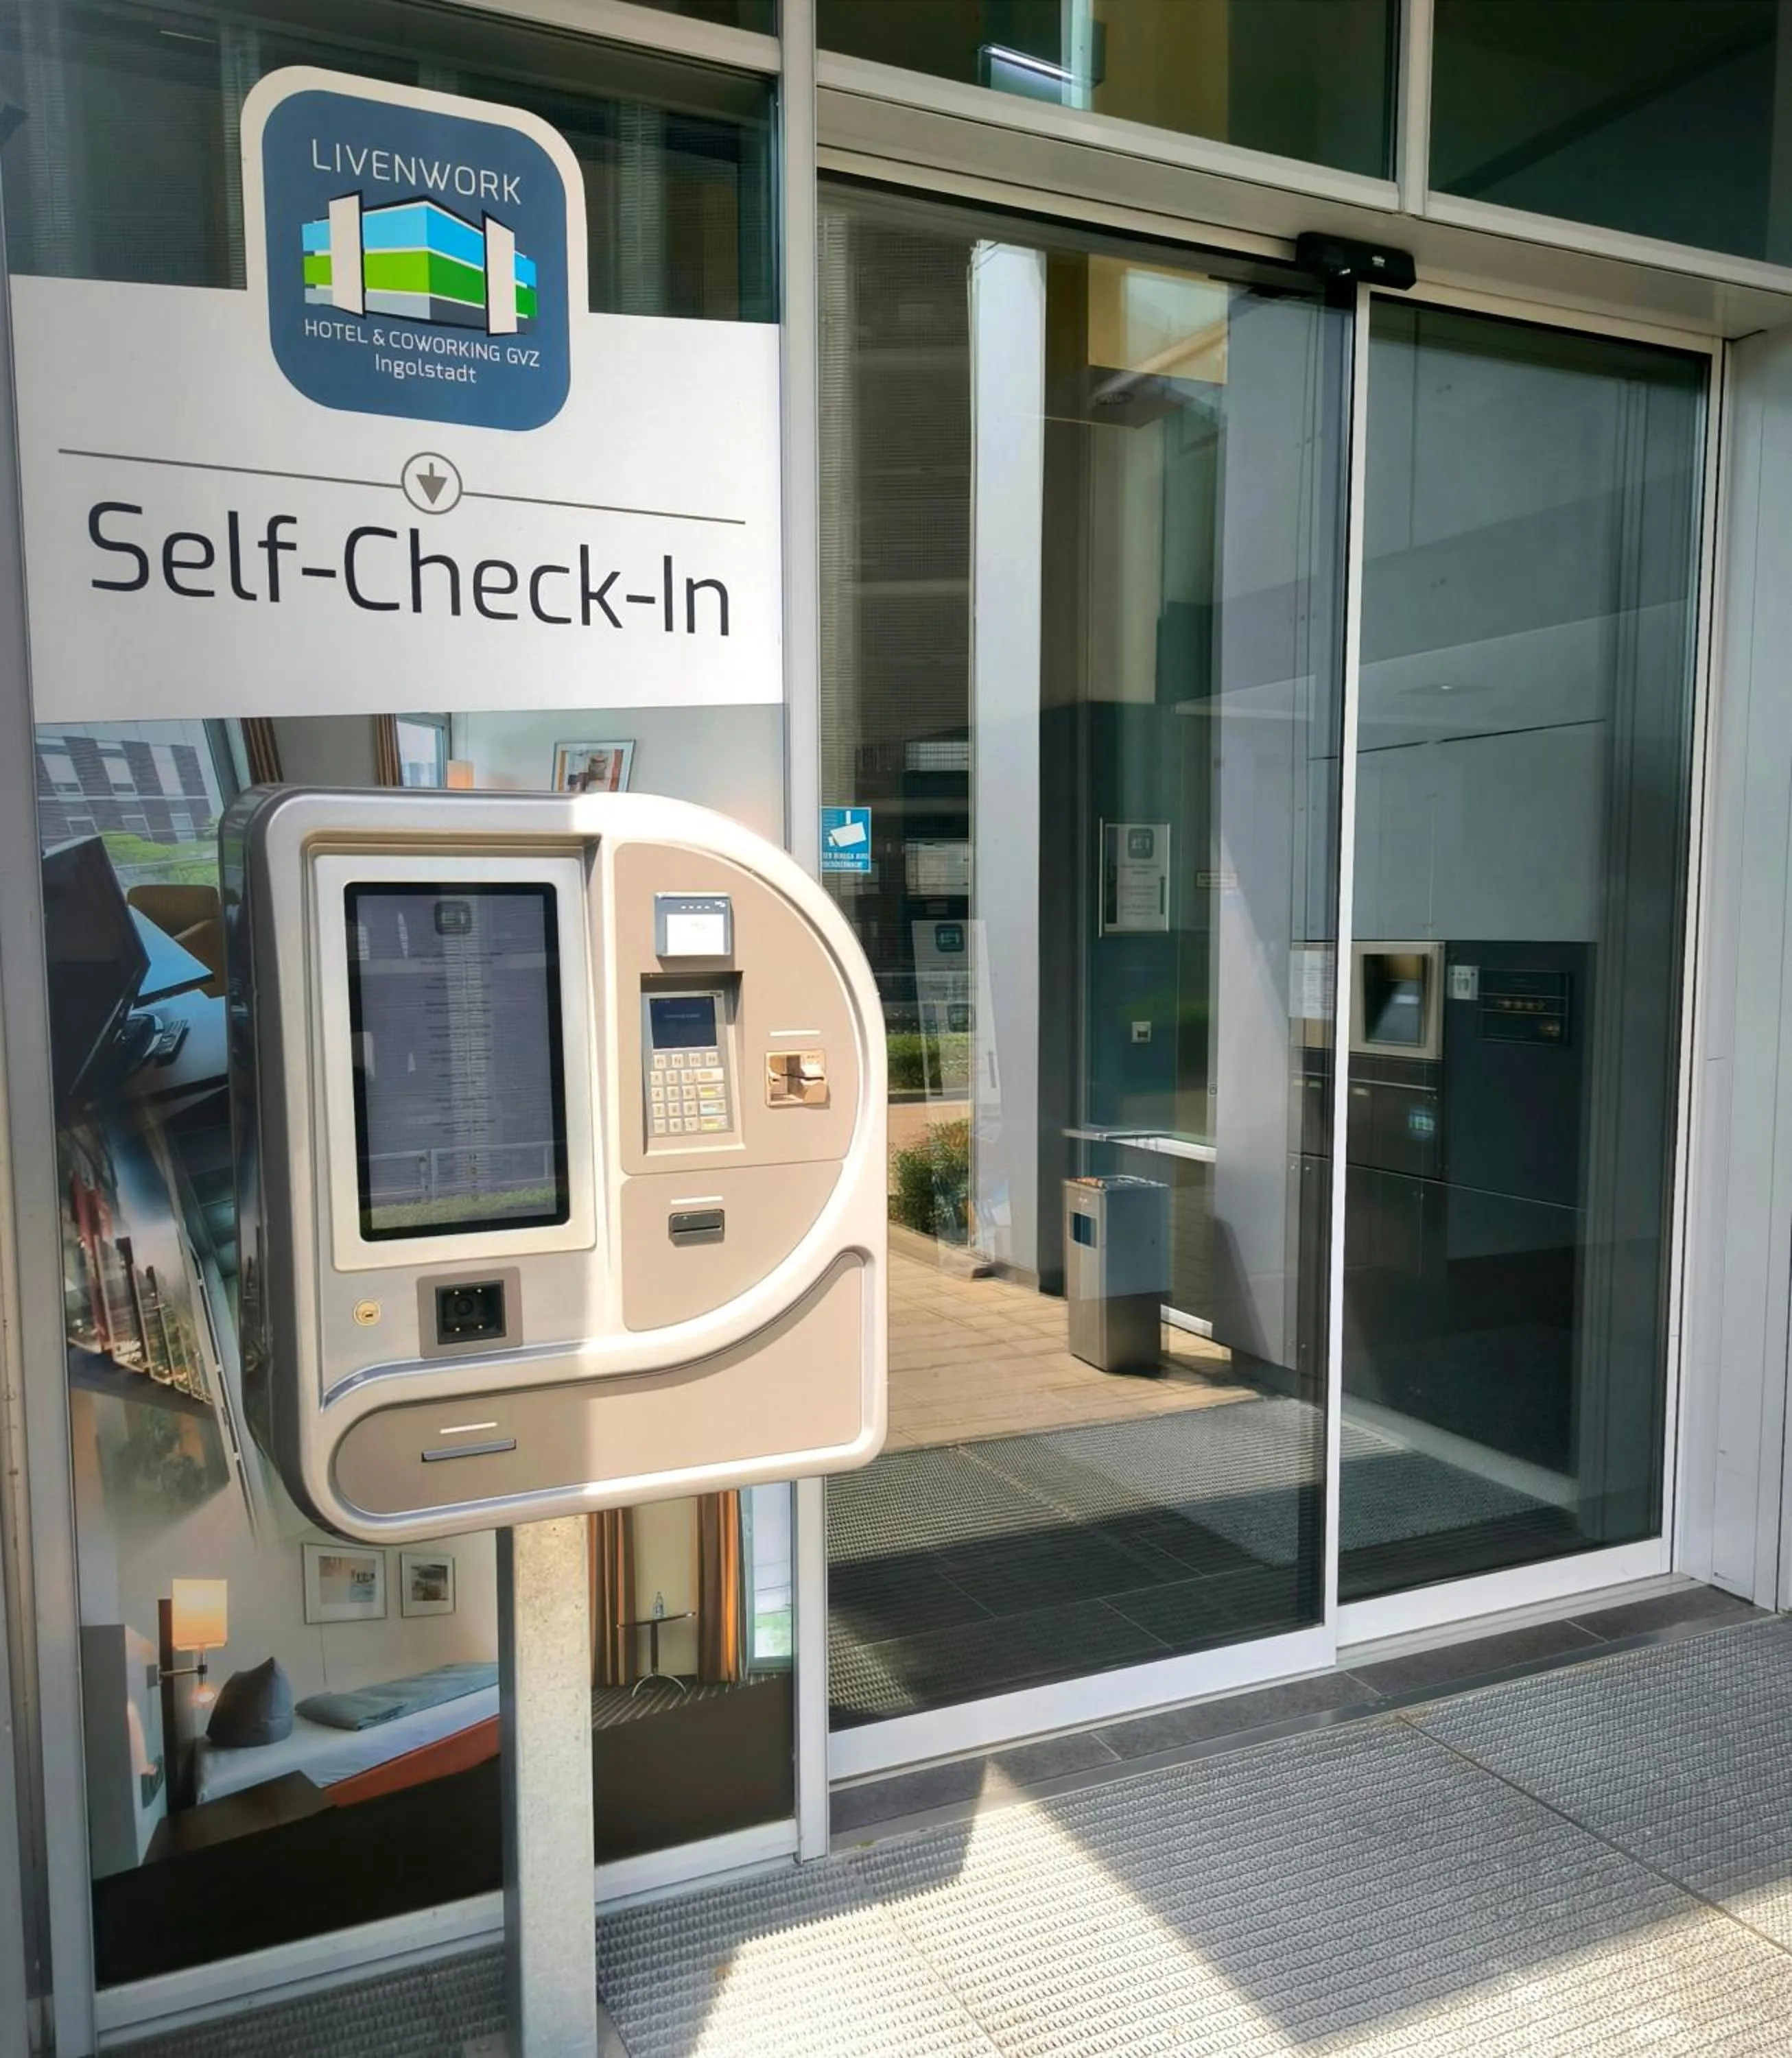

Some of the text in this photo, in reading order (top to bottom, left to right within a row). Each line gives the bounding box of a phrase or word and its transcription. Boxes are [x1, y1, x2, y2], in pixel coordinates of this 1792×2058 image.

[311, 139, 521, 205] LIVENWORK
[304, 318, 541, 368] HOTEL & COWORKING GVZ
[375, 353, 477, 384] Ingolstadt
[88, 501, 730, 637] Self-Check-In
